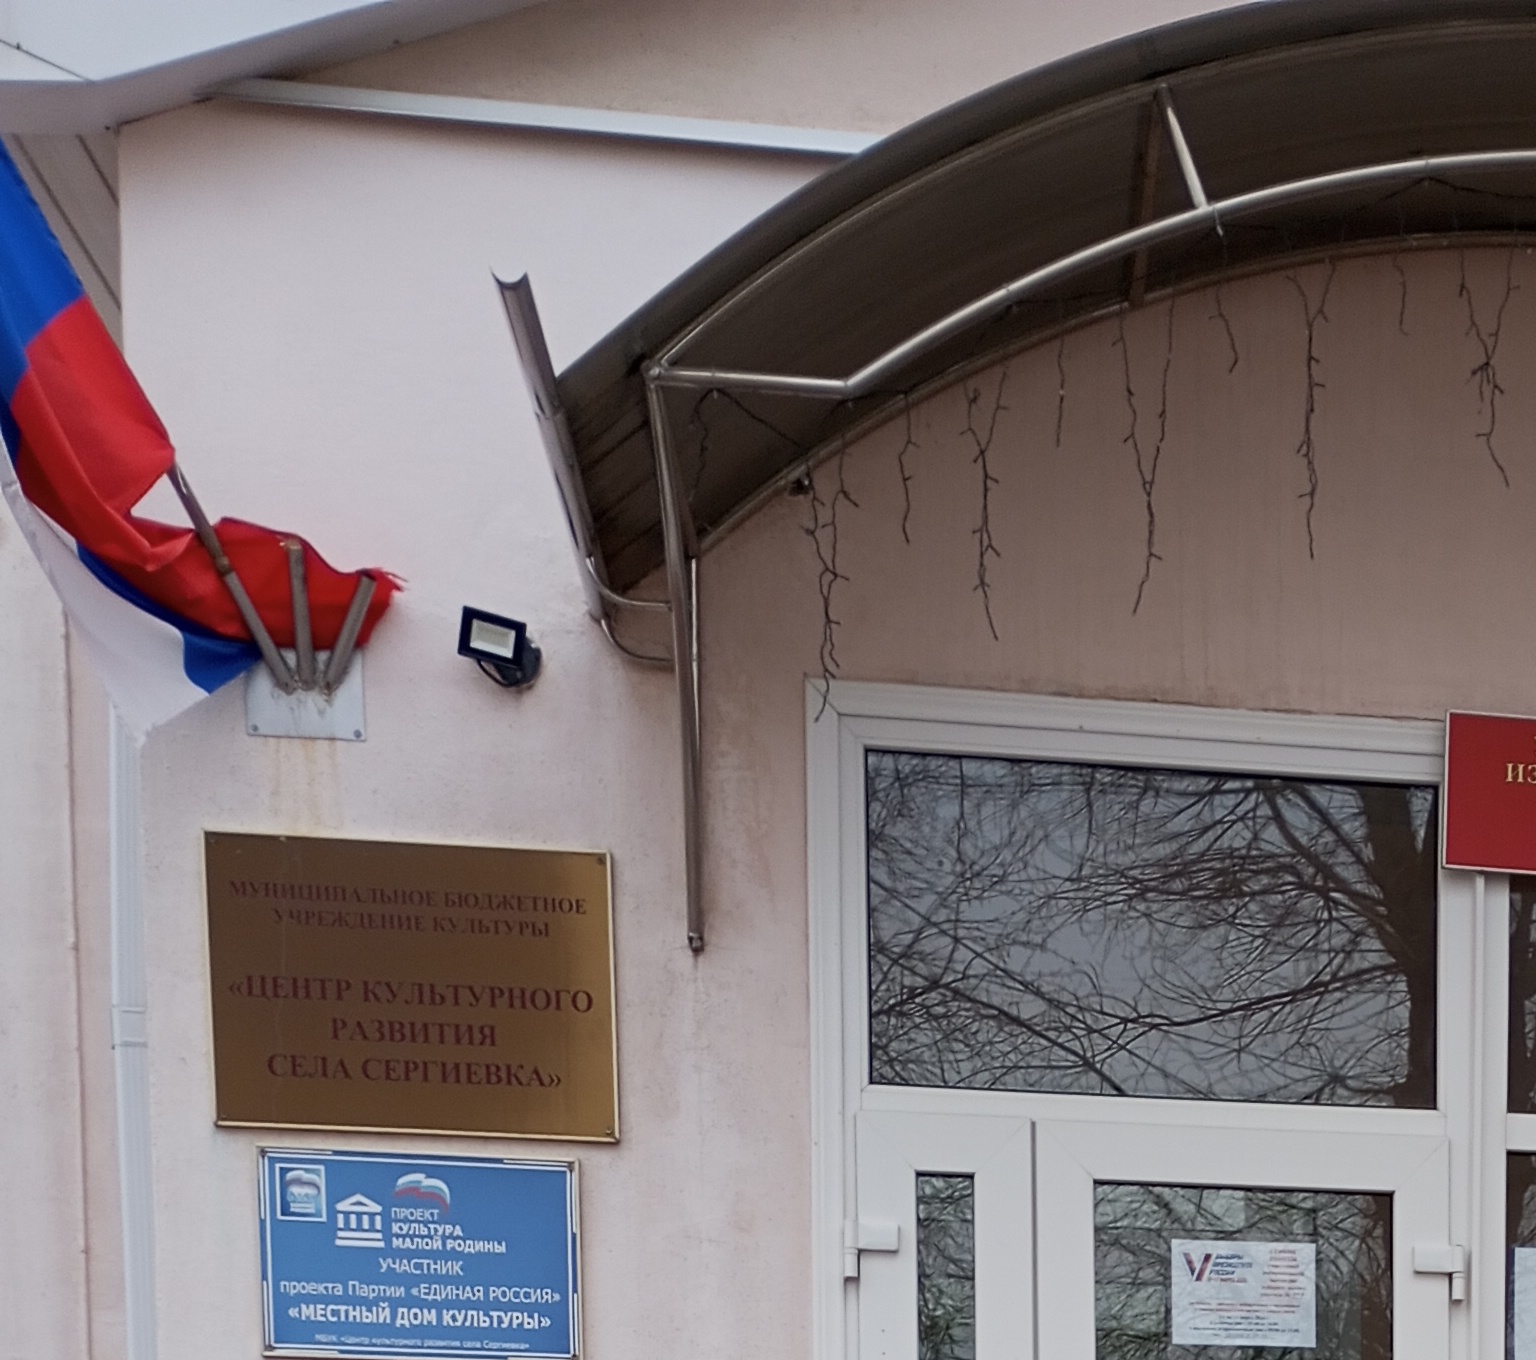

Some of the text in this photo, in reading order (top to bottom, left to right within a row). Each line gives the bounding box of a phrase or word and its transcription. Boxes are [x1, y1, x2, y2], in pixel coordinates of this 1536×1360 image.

[229, 880, 587, 915] МУНИЦИПАЛЬНОЕ БЮДЖЕТНОЕ
[272, 909, 549, 937] УЧРЕЖДЕНИЕ КУЛЬТУРЫ
[229, 975, 593, 1013] «ЦЕНТР КУЛЬТУРНОГО
[331, 1018, 497, 1047] РАЗВИТИЯ
[267, 1054, 562, 1088] СЕЛА СЕРГИЕВКА»
[391, 1208, 439, 1221] ПРОЕКТ
[392, 1222, 463, 1236] КУЛЬТУРА
[391, 1237, 506, 1254] МАЛОЙ РОДИНЫ
[379, 1257, 463, 1275] УЧАСТНИК
[280, 1281, 560, 1303] проекта Партии «ЕДИНАЯ РОССИЯ»
[288, 1302, 550, 1329] «МЕСТНЫЙ ДОМ КУЛЬТУРЫ»
